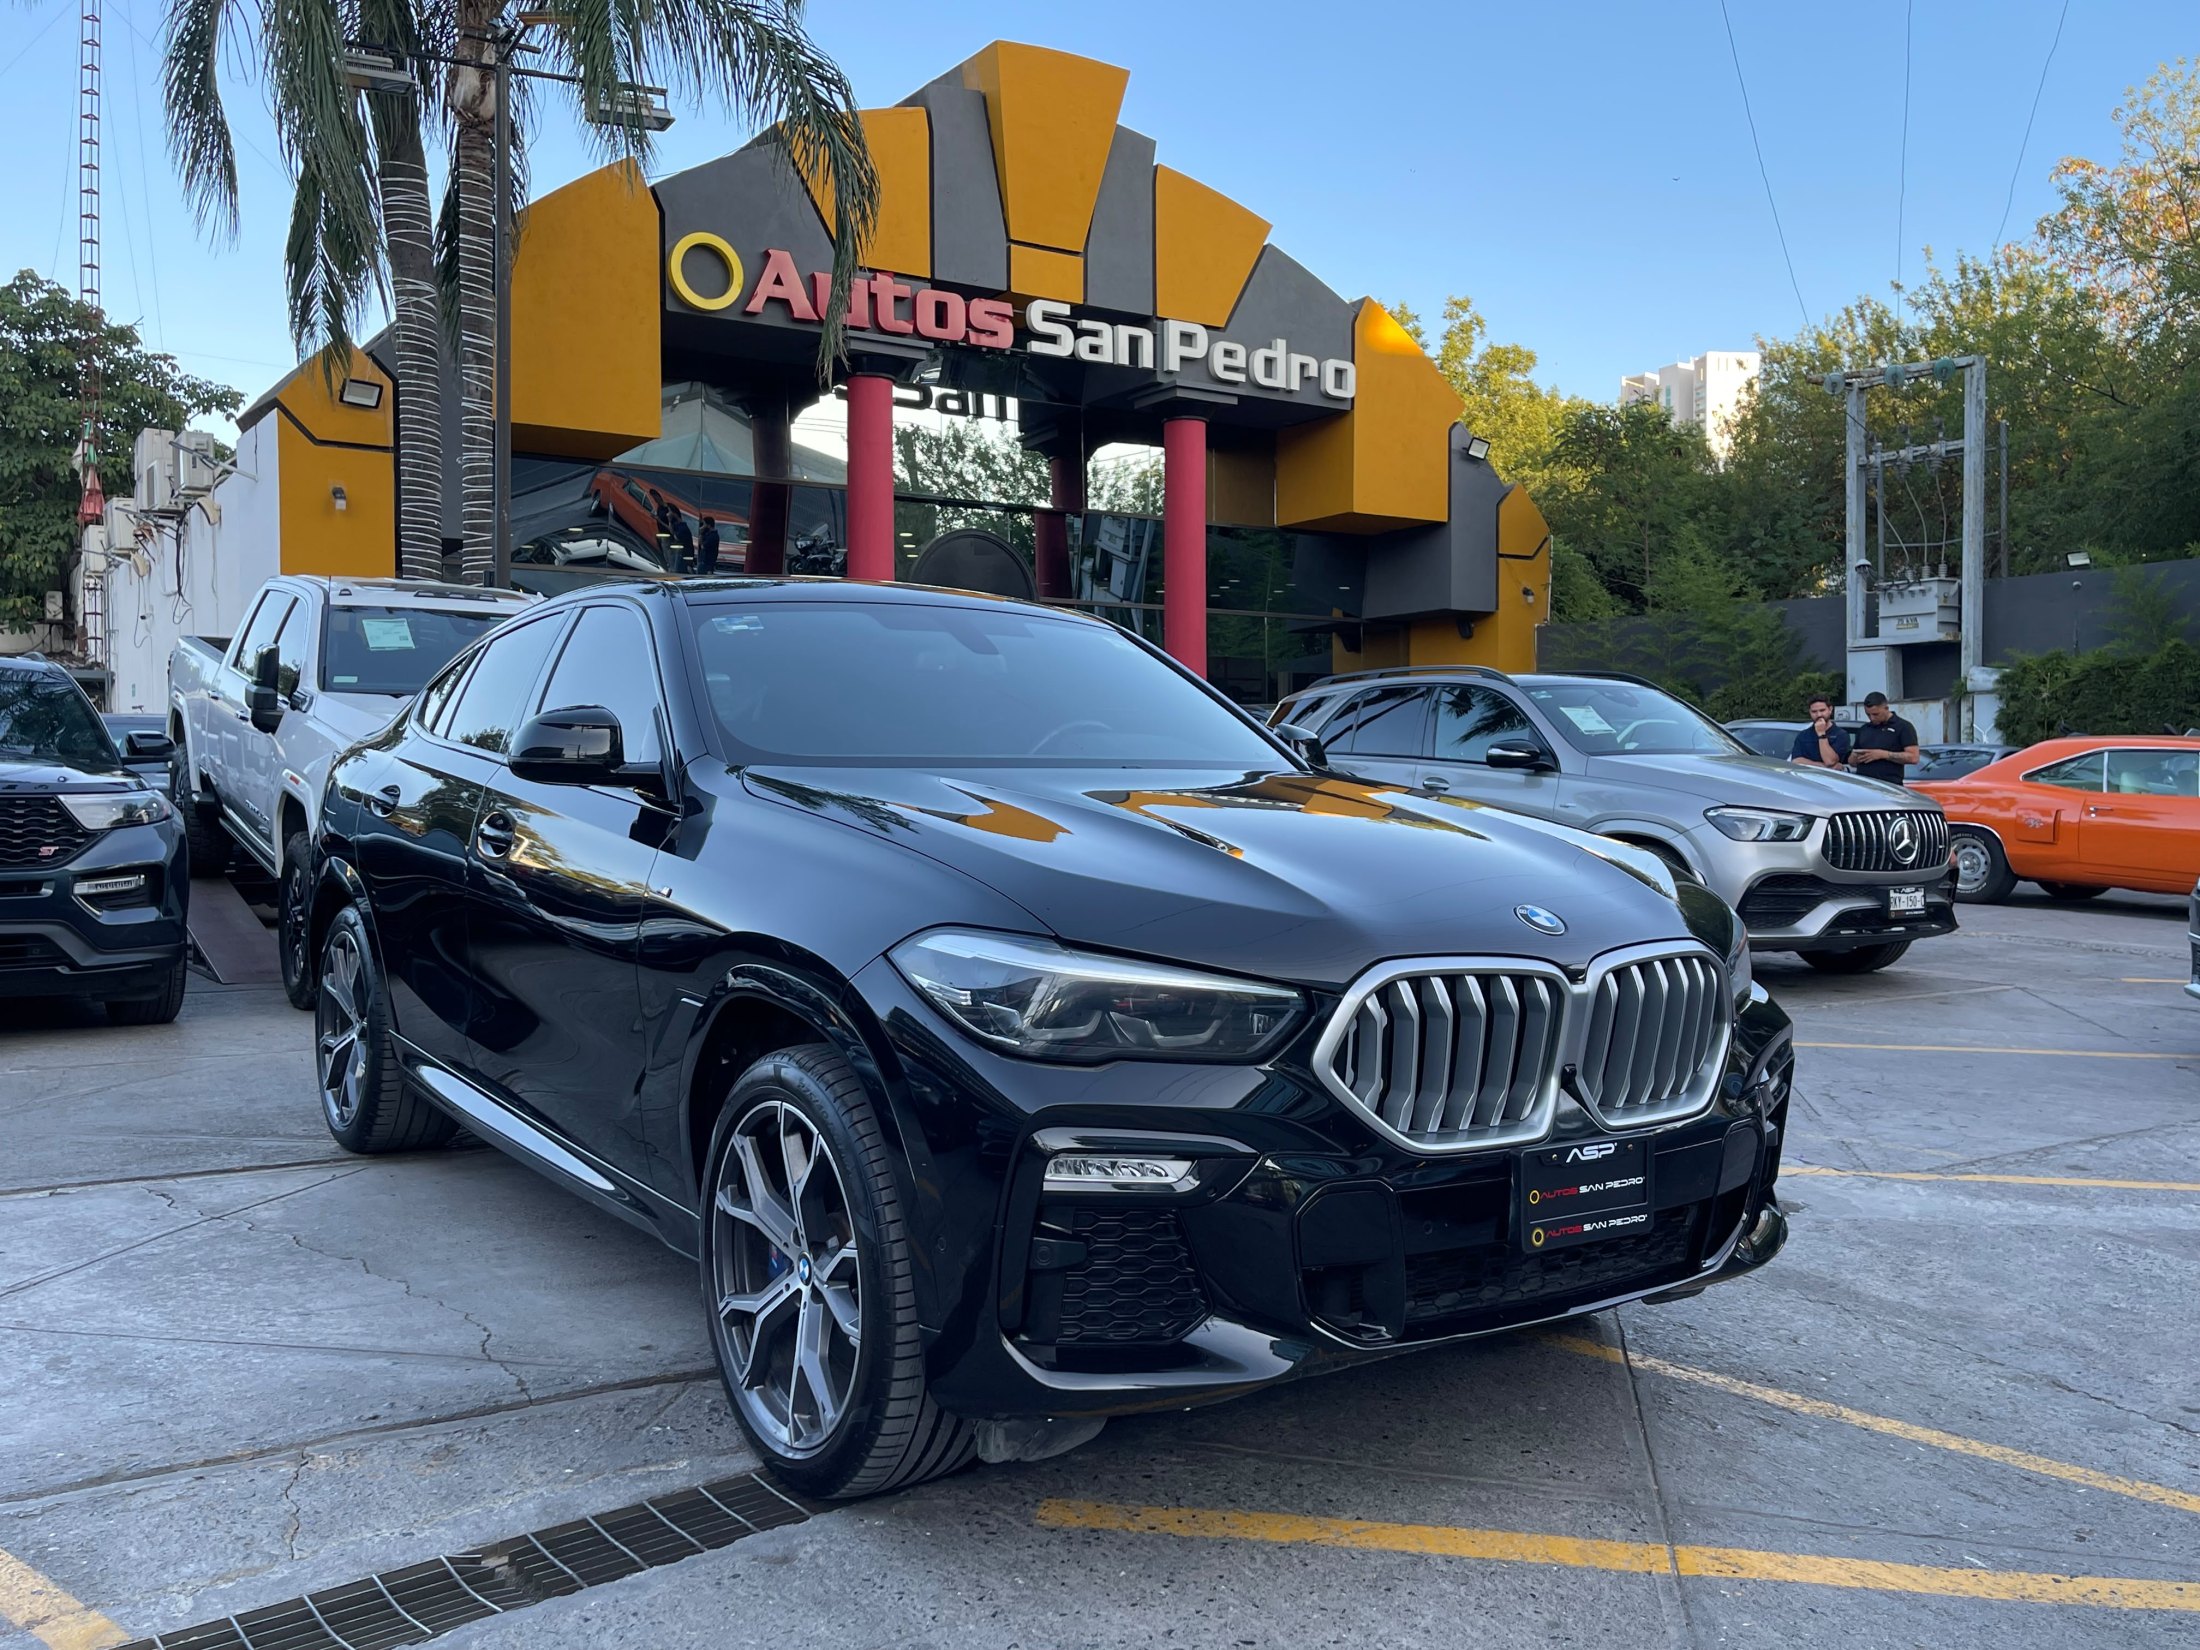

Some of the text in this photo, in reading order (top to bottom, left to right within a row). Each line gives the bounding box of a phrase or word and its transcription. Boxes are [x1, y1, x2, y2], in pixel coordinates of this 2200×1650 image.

[745, 248, 1357, 399] Autos San Pedro
[1565, 1142, 1616, 1163] ASP
[1540, 1177, 1644, 1199] AUTOS SAN PEDRO
[1546, 1214, 1646, 1238] AUTOS SAN PEDRO
